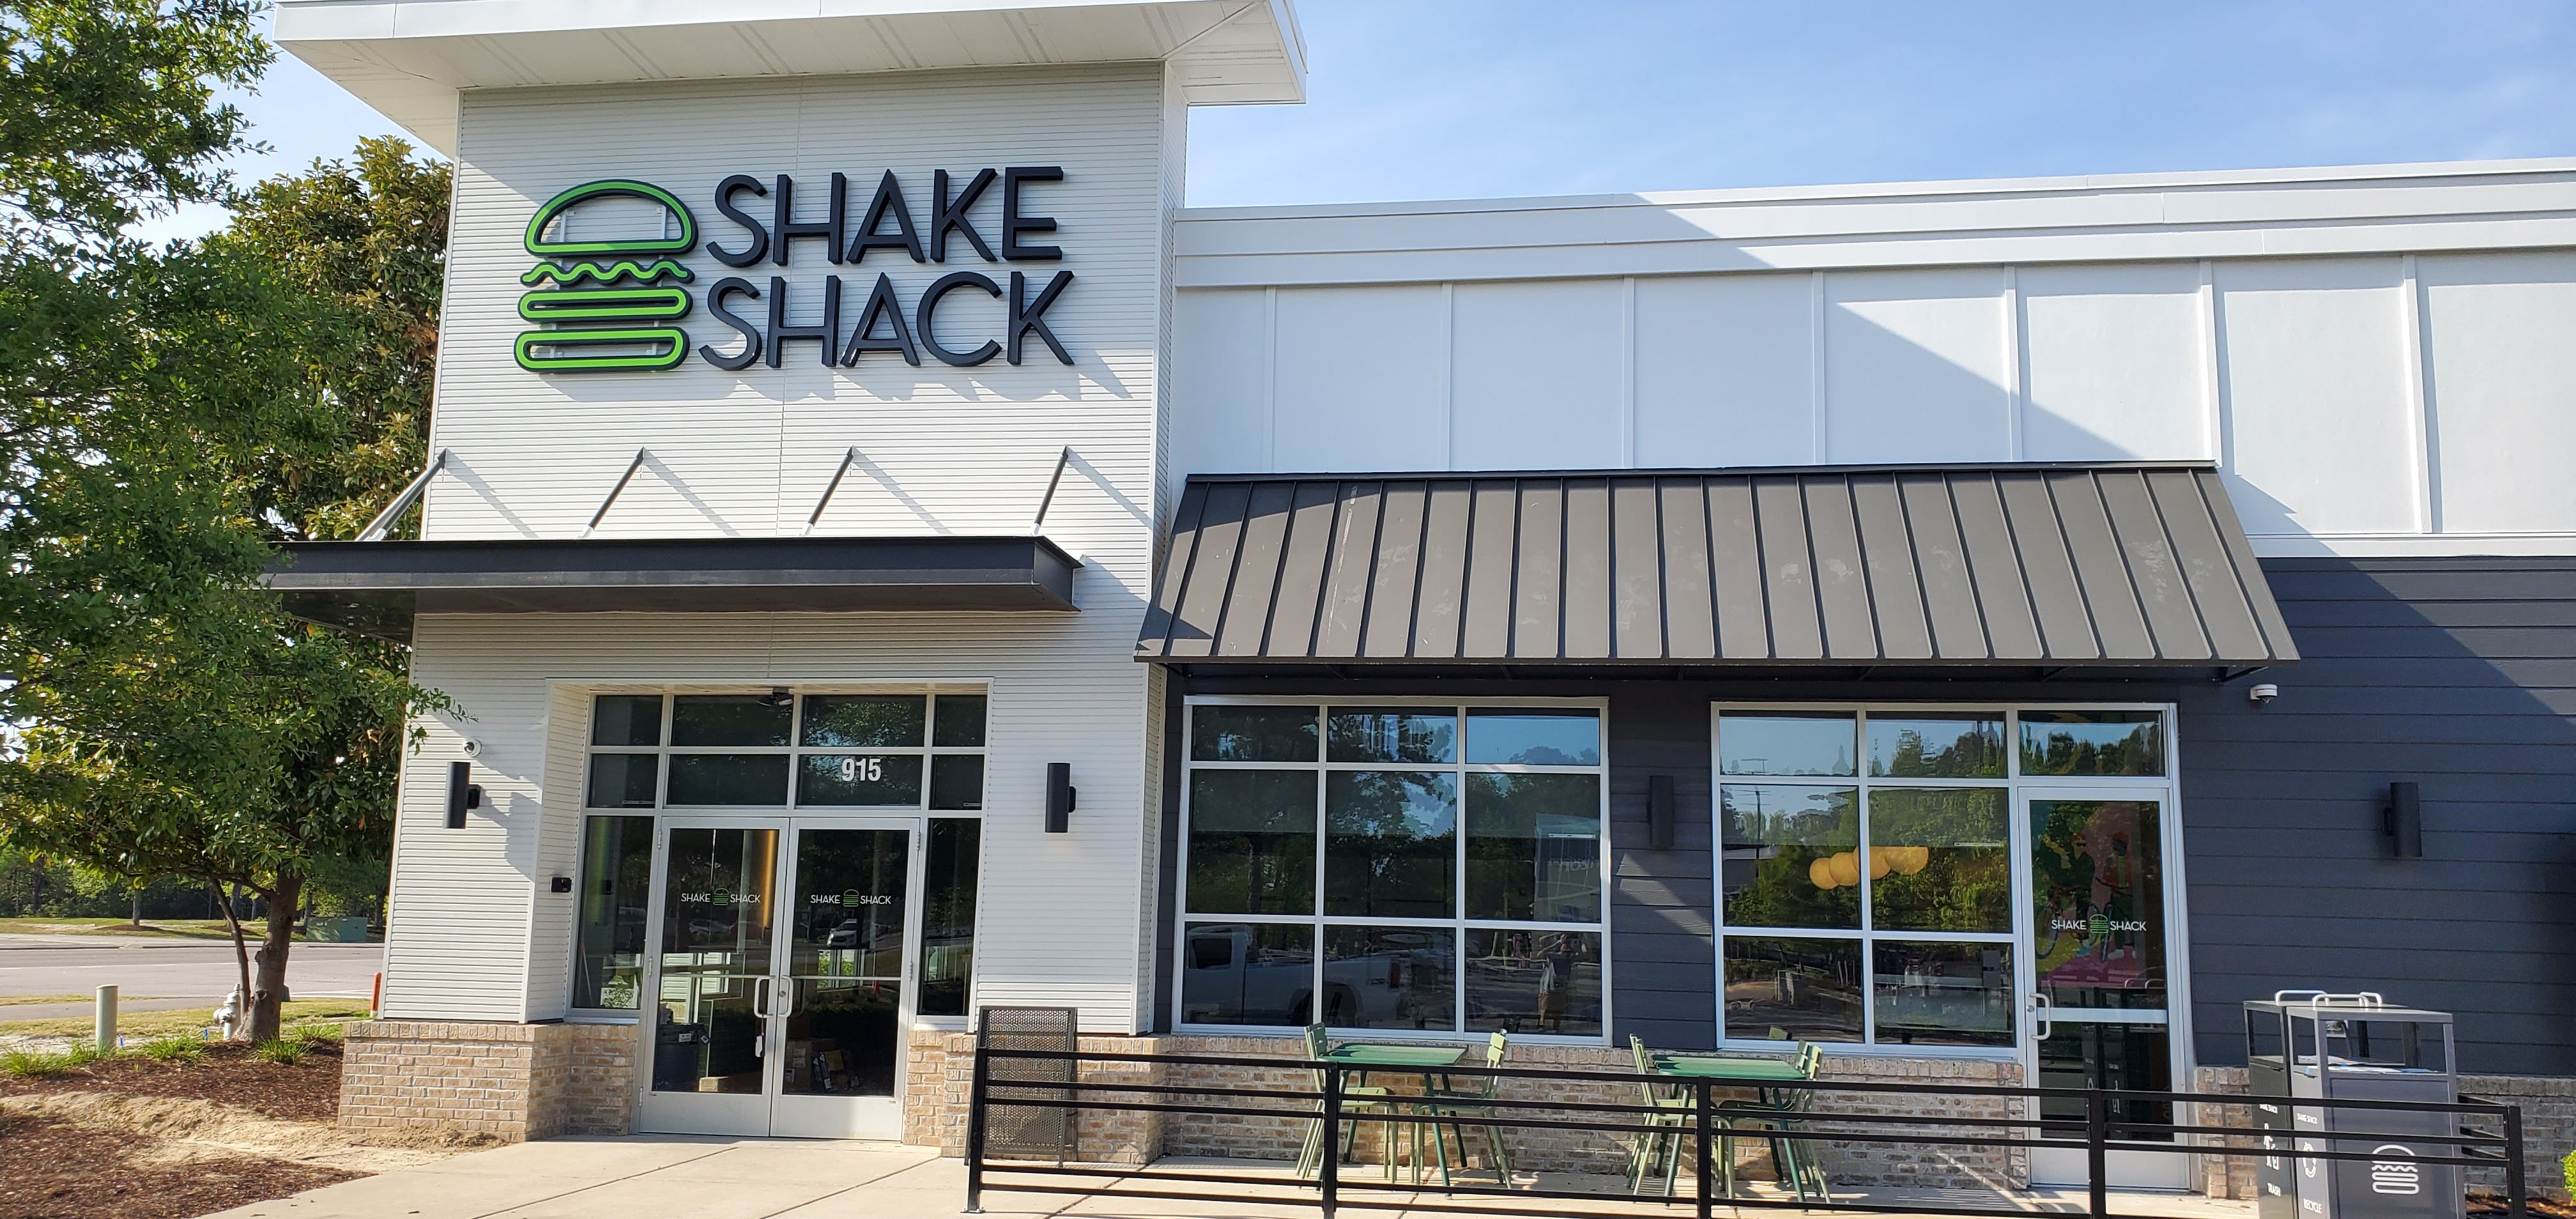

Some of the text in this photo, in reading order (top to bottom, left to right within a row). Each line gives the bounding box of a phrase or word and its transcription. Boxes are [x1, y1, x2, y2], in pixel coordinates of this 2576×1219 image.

[706, 166, 1063, 268] SHAKE
[699, 271, 1075, 371] SHACK
[842, 758, 881, 781] 915
[681, 893, 761, 903] SHAKE SHACK
[810, 894, 891, 904] SHAKE SHACK
[2051, 920, 2147, 931] SHAKE SHACK
